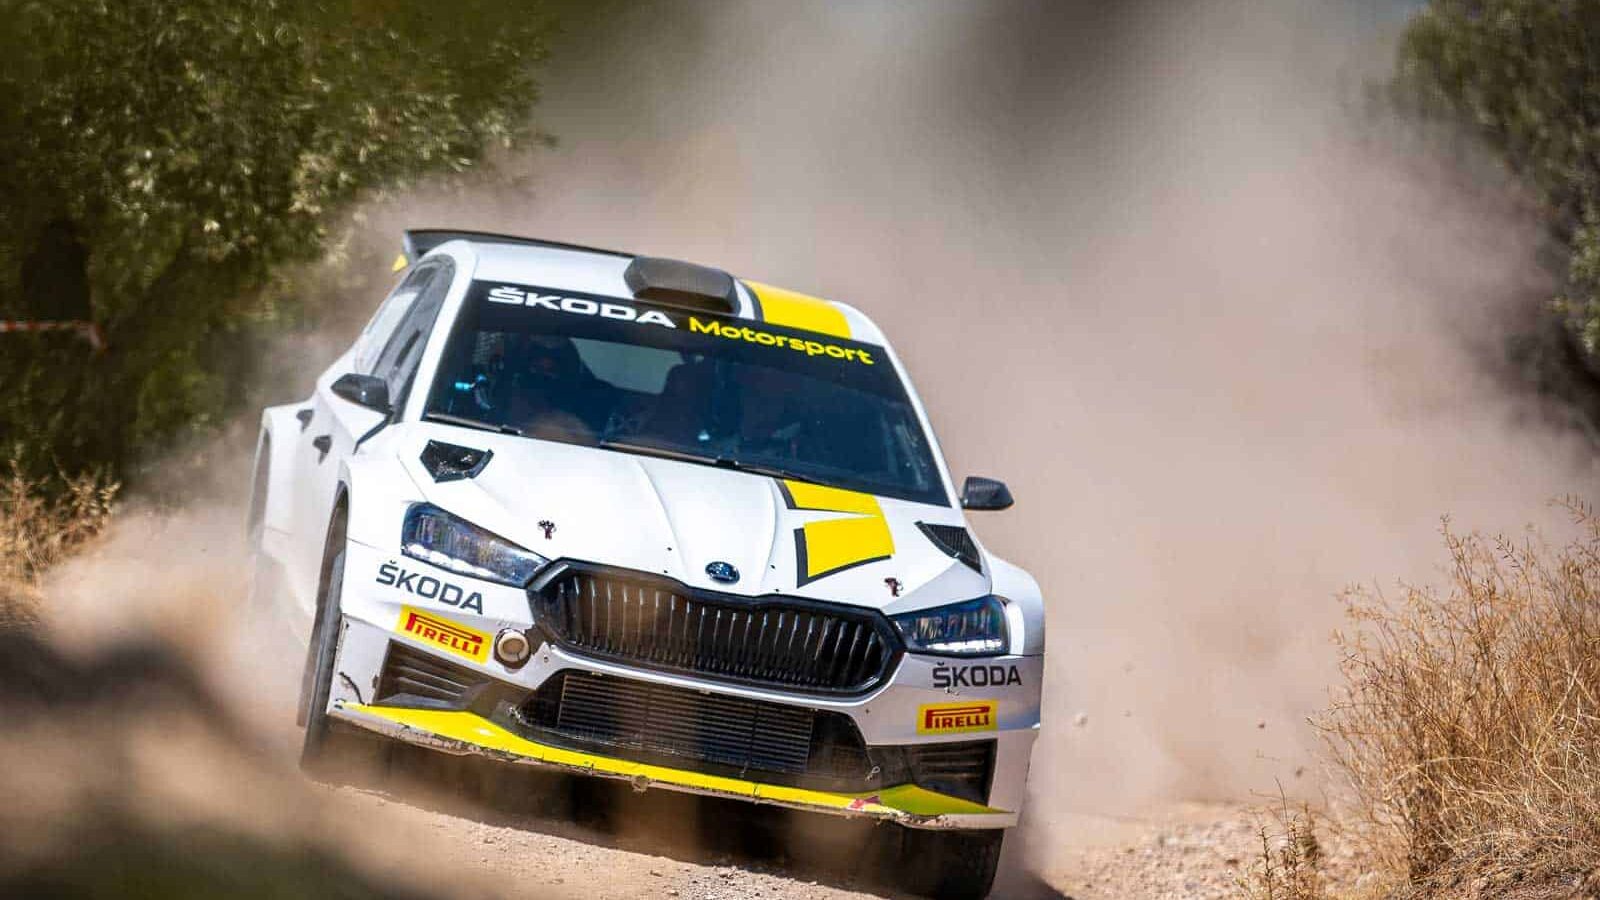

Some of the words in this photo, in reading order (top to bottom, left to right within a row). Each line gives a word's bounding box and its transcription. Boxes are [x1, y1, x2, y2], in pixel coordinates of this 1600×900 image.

[487, 286, 676, 328] ŠKODA
[688, 317, 874, 364] Motorsport
[376, 560, 483, 614] ŠKODA
[405, 612, 483, 655] PIRELLI
[932, 662, 1022, 688] ŠKODA
[925, 706, 991, 729] PIRELLI
